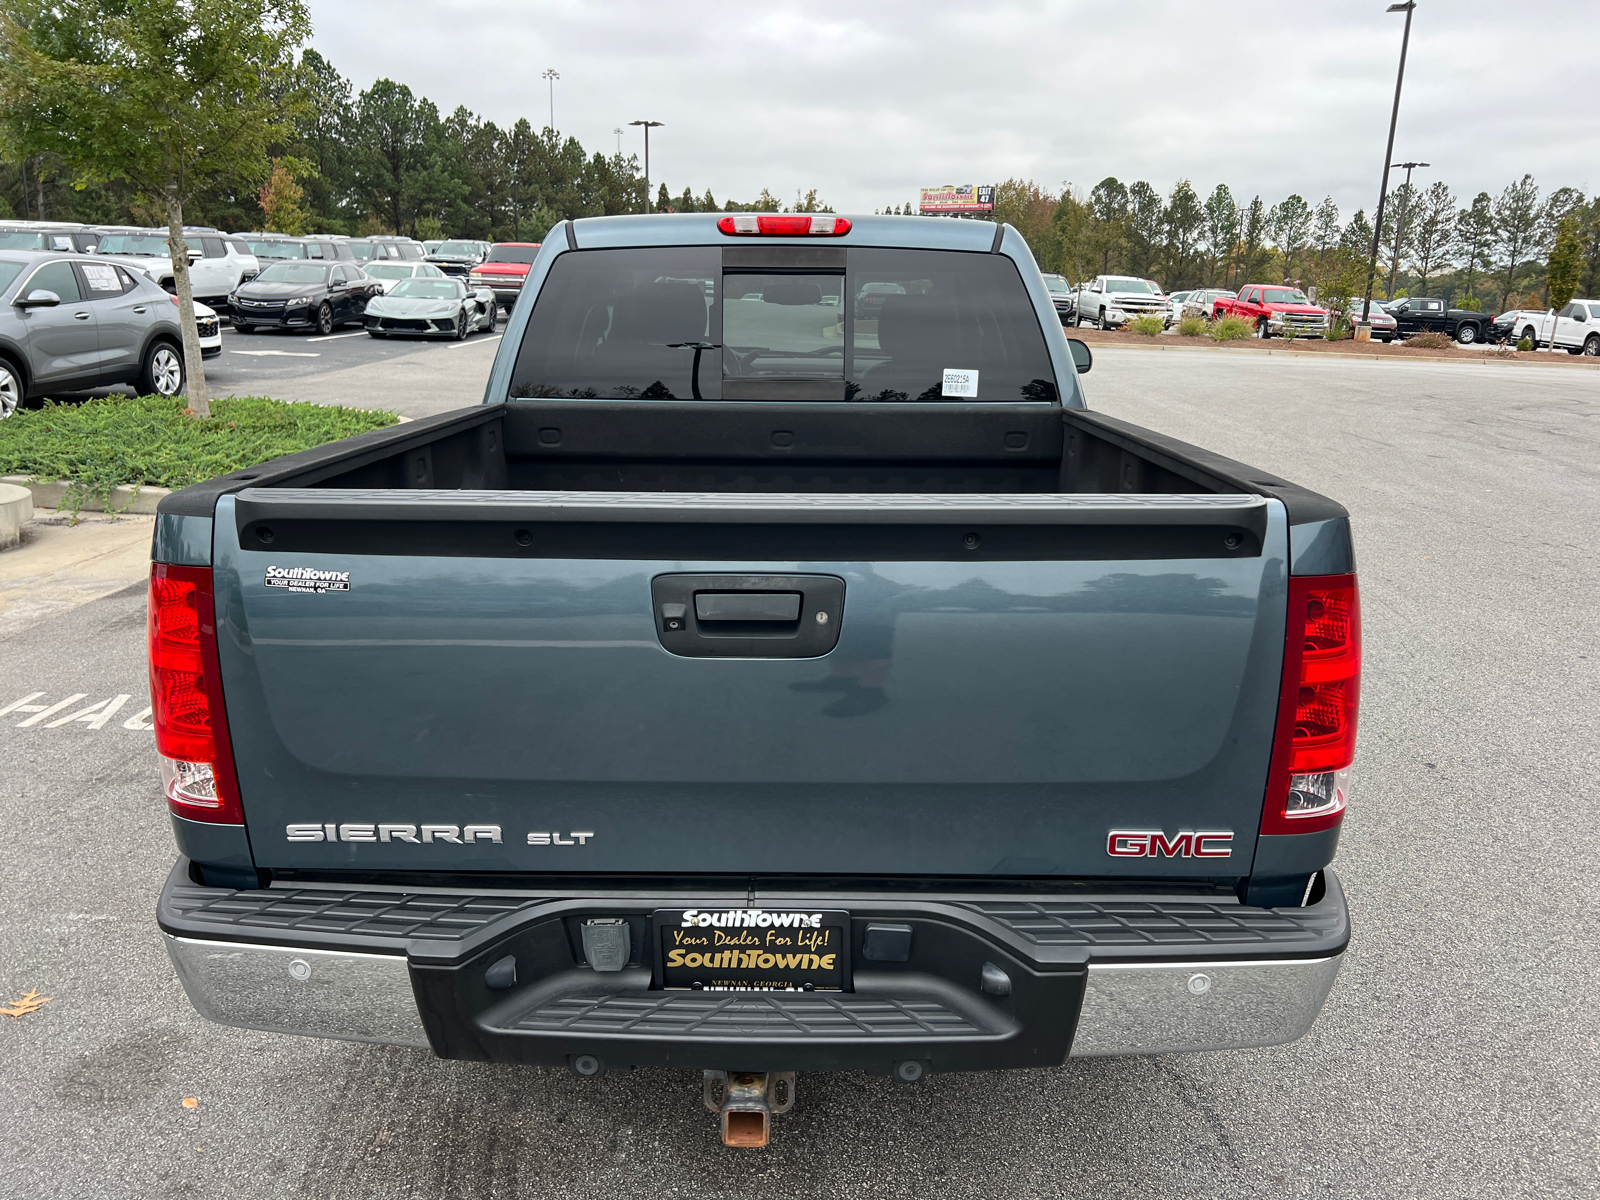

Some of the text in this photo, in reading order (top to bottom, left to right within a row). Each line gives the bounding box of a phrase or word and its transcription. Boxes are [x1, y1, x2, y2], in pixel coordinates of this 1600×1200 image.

[979, 187, 992, 195] EXIT
[980, 195, 990, 203] 47
[266, 565, 350, 582] SouthTowne
[270, 579, 289, 587] YOUR
[289, 580, 315, 588] DEALER
[286, 823, 595, 846] SIERRA SLT
[1106, 828, 1235, 858] GMC
[681, 909, 823, 928] SouthTowne
[673, 930, 830, 952] Your Dealer For Life!
[666, 949, 837, 970] SouthTowne
